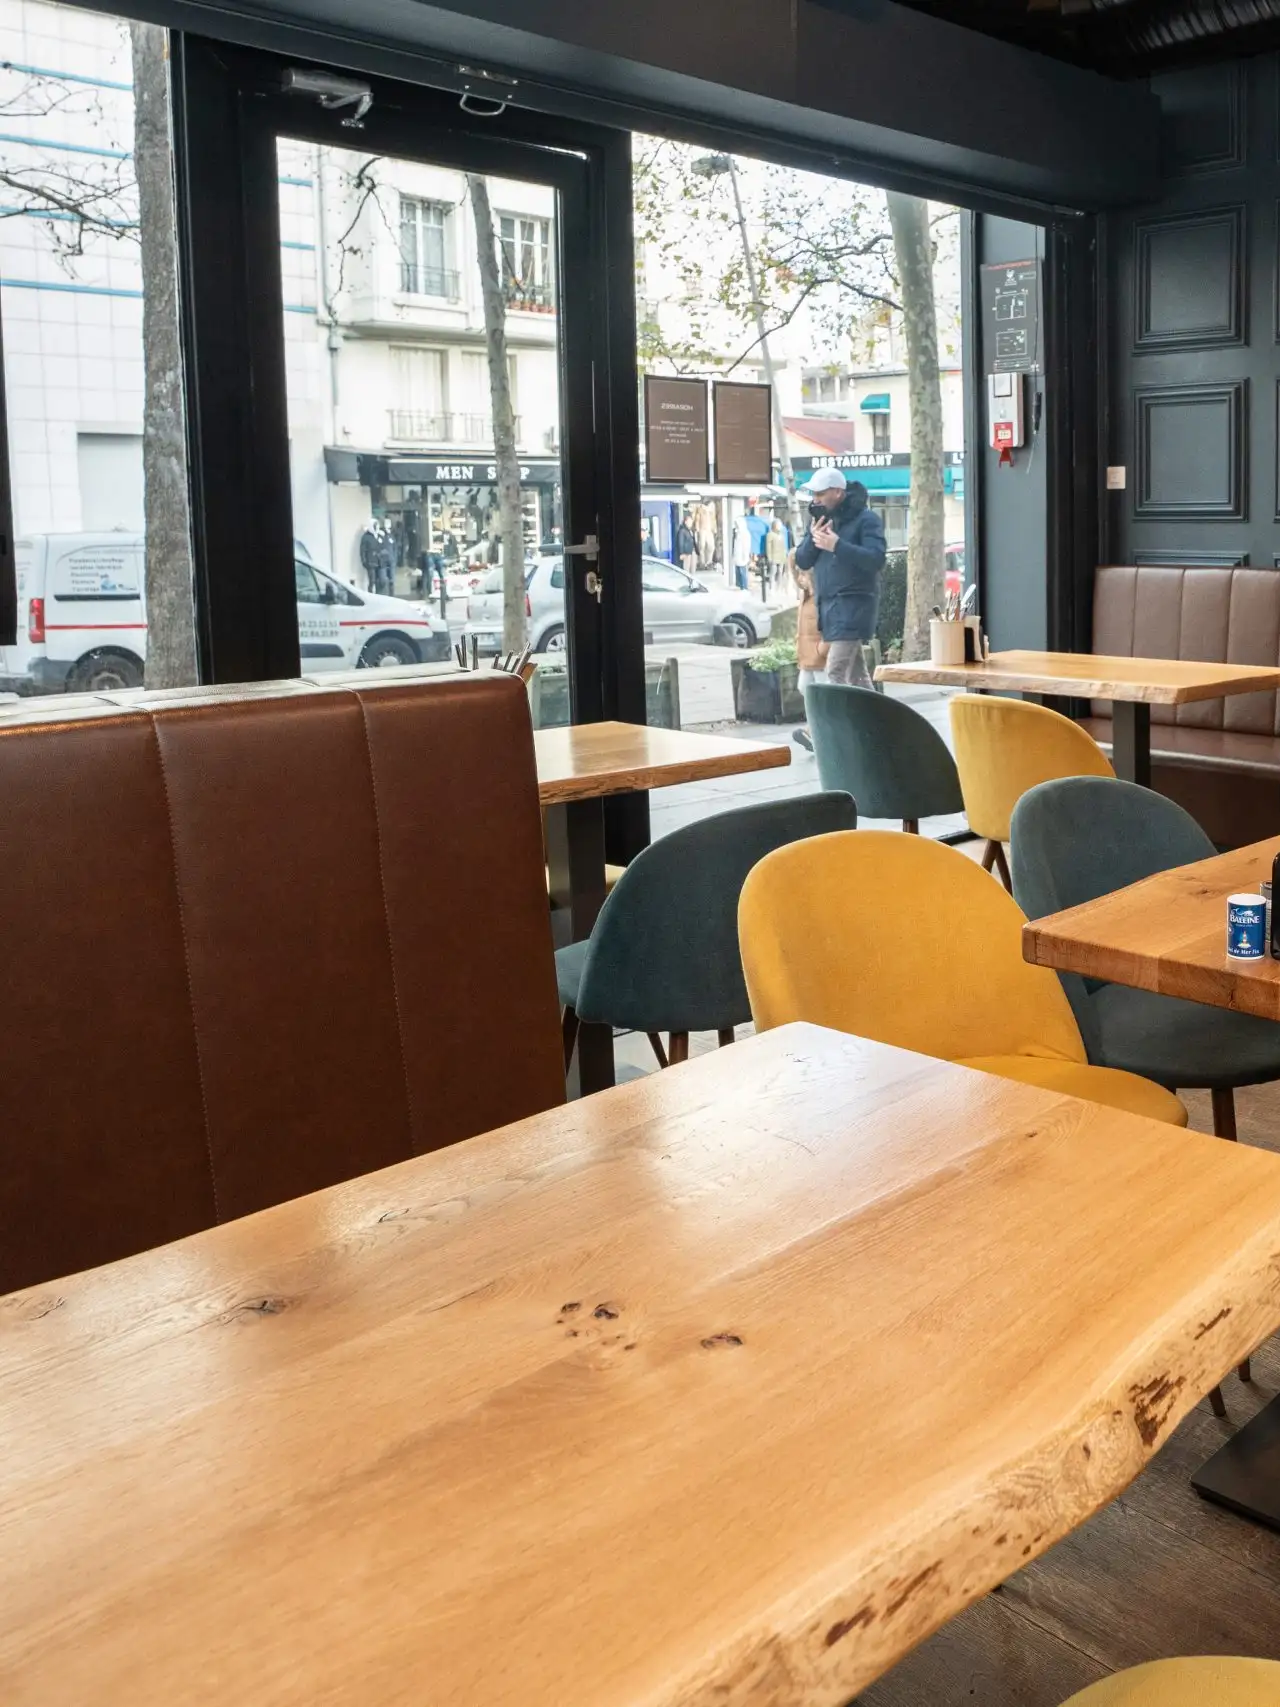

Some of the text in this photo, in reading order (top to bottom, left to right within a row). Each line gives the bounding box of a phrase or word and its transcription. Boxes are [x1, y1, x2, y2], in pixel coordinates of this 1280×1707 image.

[811, 454, 893, 468] RESTAURANT
[436, 466, 530, 480] MEN SP
[1230, 914, 1260, 923] BALEINE
